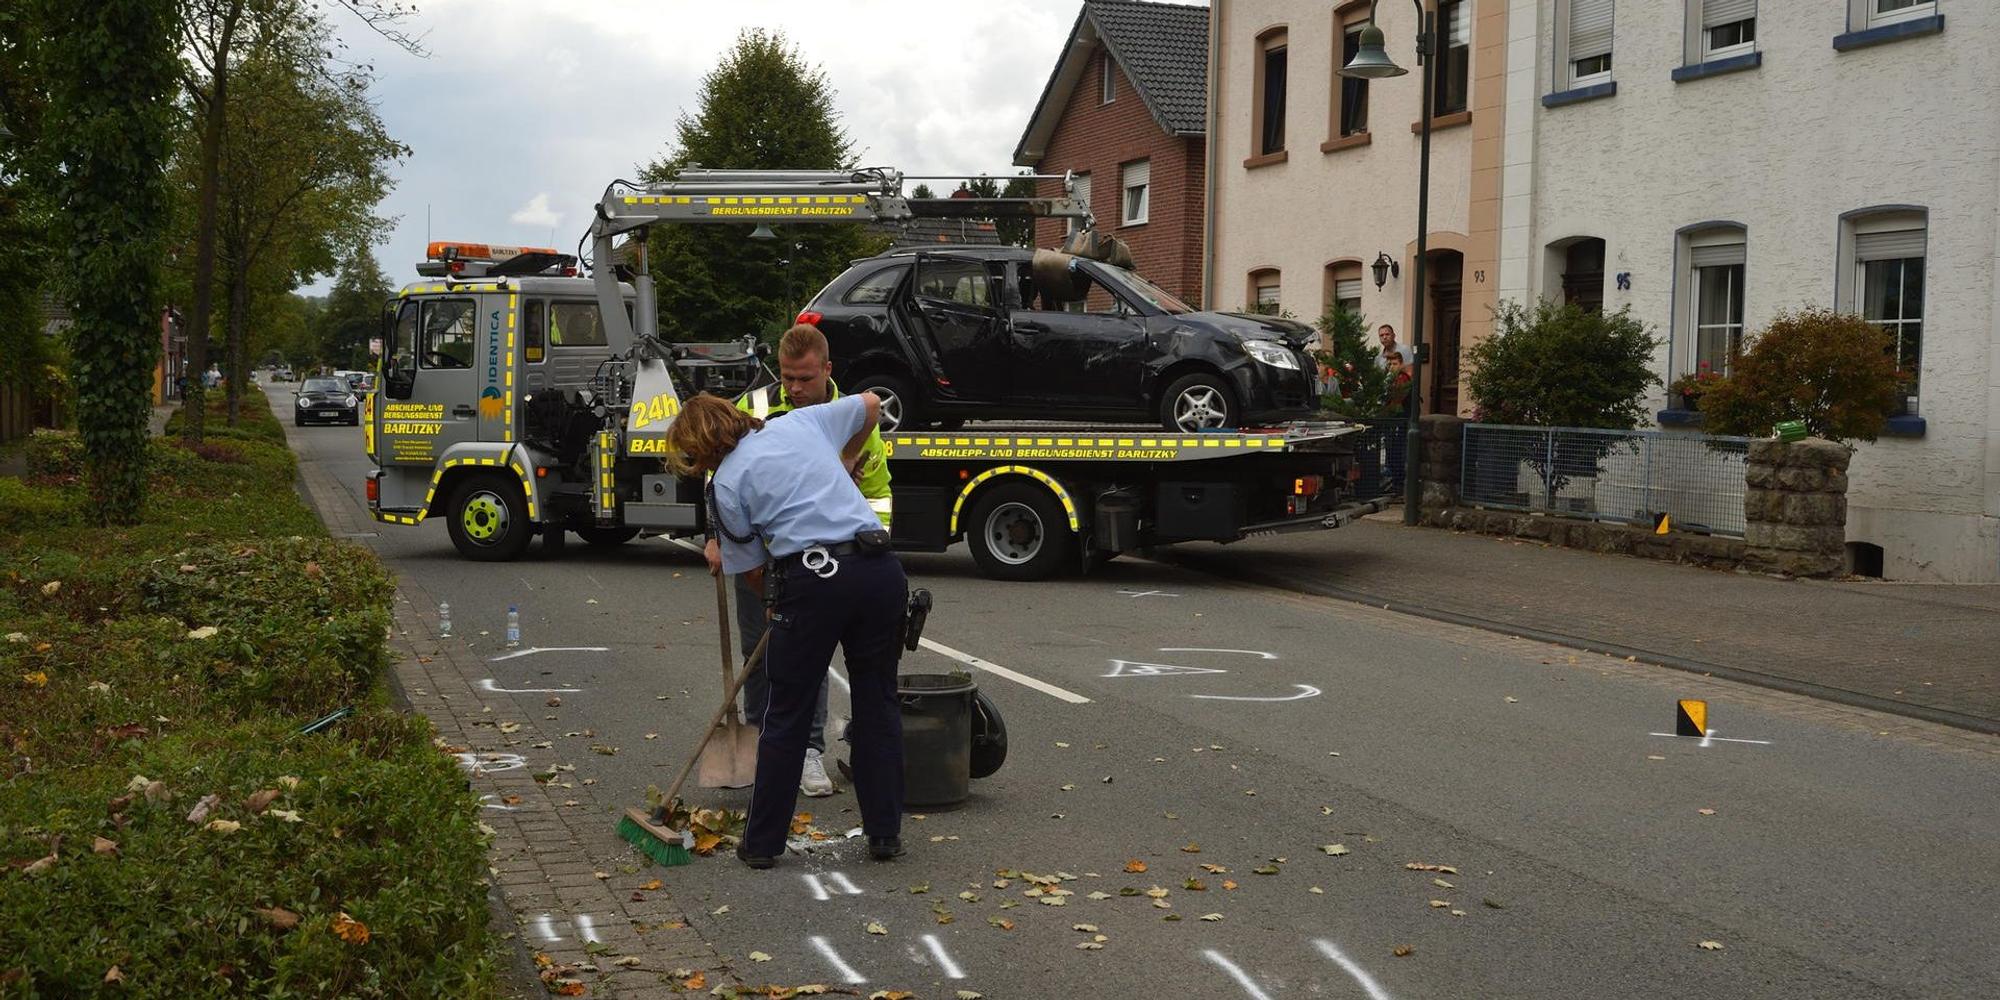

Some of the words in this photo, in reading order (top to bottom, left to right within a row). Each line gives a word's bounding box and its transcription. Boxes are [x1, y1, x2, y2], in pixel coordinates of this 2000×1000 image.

[712, 207, 798, 215] BERGUNGSDIENST
[801, 207, 855, 215] BARUTZKY
[1474, 270, 1485, 283] 93
[1616, 272, 1631, 290] 95
[488, 310, 500, 383] IDENTICA
[385, 404, 427, 412] ABSCHLEPP-
[428, 404, 444, 412] UND
[633, 393, 679, 429] 24h
[383, 411, 443, 419] BERGUNGSDIENST
[383, 423, 443, 434] BARUTZKY
[630, 439, 667, 453] BAR
[920, 448, 987, 457] ABSCHLEPP-
[989, 448, 1013, 457] UND
[1016, 448, 1115, 459] BERGUNGSDIENST
[1117, 449, 1179, 459] BARUTZKY
